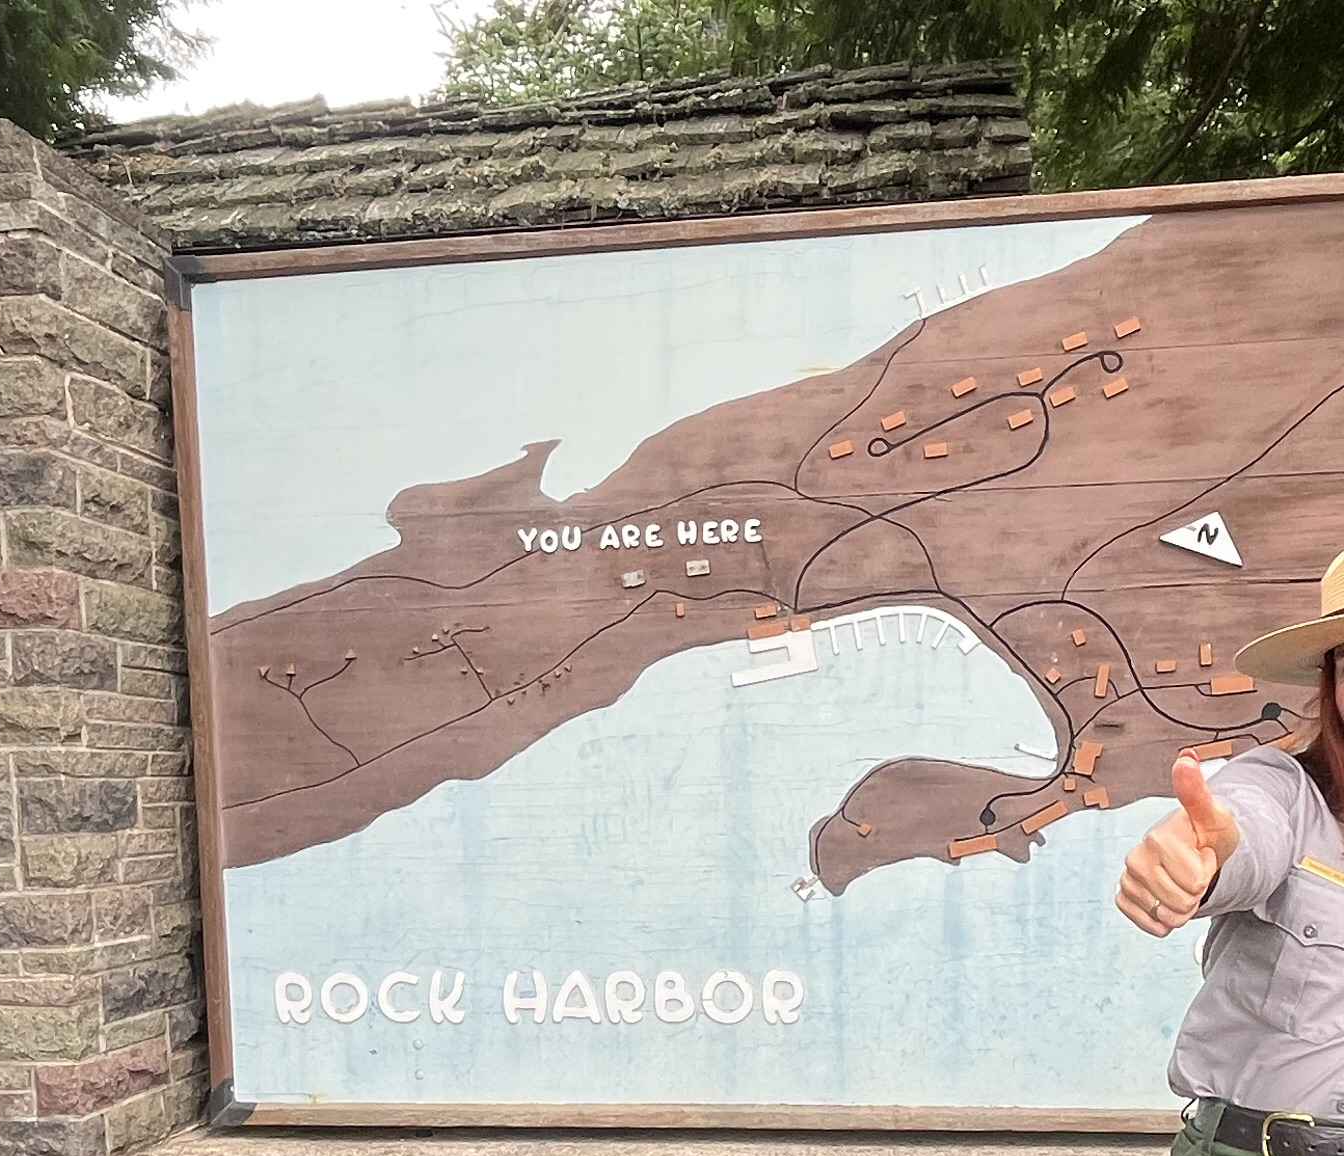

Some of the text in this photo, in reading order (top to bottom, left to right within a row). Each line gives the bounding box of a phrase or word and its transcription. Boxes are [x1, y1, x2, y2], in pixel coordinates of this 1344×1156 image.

[517, 518, 763, 553] YOU ARE HERE
[1197, 522, 1219, 545] N
[274, 969, 805, 1025] ROCK HARBOR
